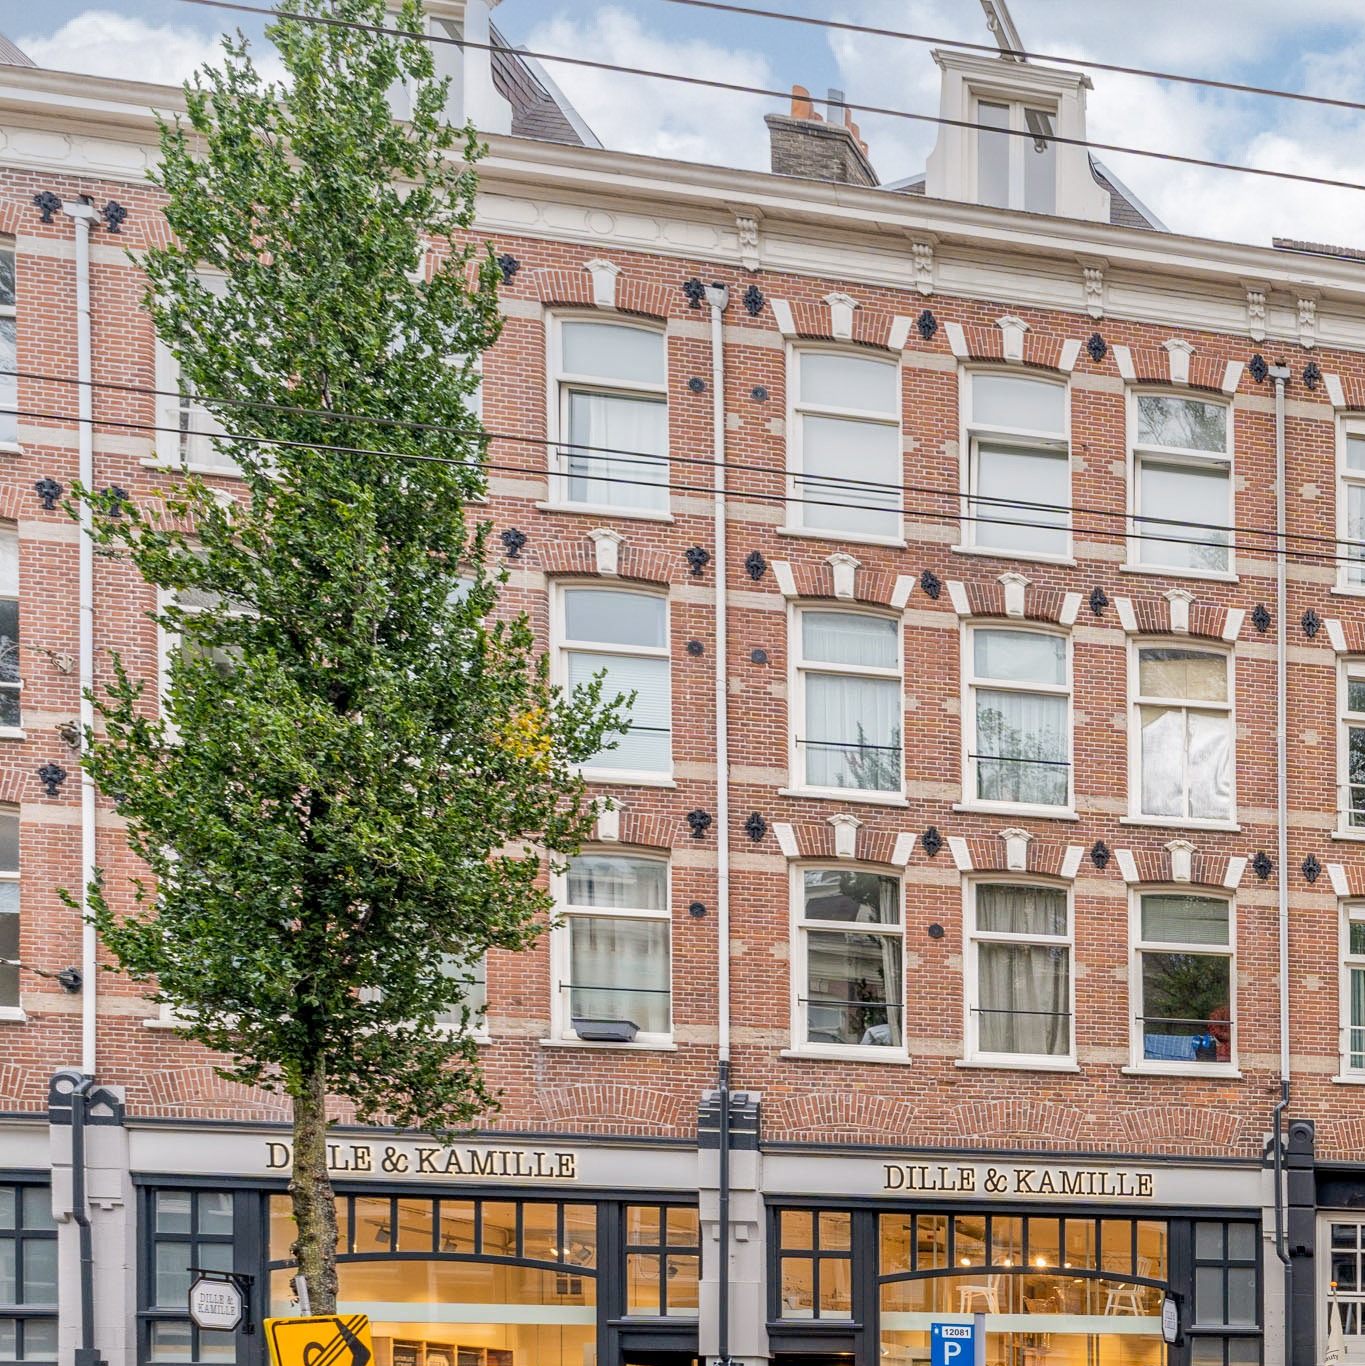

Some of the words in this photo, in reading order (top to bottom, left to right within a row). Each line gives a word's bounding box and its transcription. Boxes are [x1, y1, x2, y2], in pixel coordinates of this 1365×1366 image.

[266, 1142, 371, 1171] DLE
[381, 1146, 409, 1173] &
[415, 1147, 575, 1178] KAMILLE
[884, 1165, 975, 1192] DILLE
[984, 1168, 1008, 1193] &
[1013, 1170, 1153, 1197] KAMILLE
[200, 1292, 225, 1304] DILLE
[227, 1297, 234, 1305] &
[198, 1303, 236, 1316] KAMILLE
[944, 1328, 969, 1336] 12081
[944, 1341, 962, 1366] P
